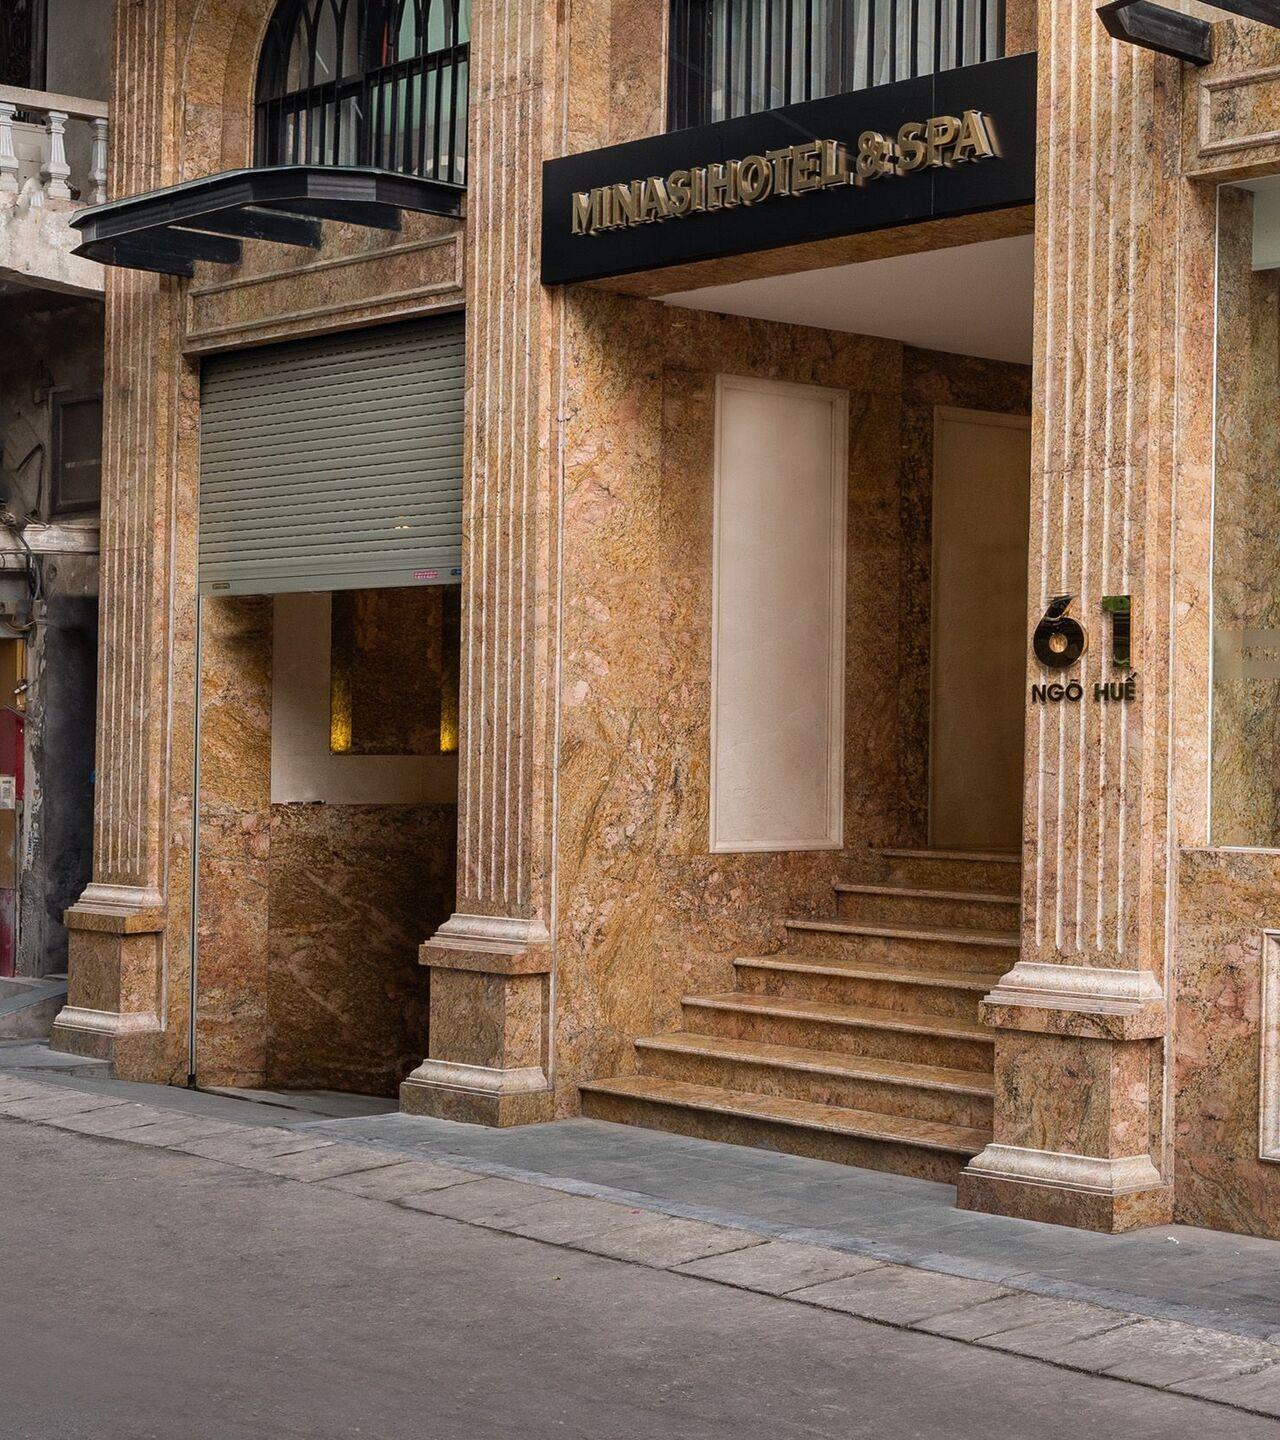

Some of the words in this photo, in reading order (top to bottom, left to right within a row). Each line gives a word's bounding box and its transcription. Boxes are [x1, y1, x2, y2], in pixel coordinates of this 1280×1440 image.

[571, 166, 706, 236] MINASI
[706, 139, 849, 209] HOTEL
[857, 131, 892, 180] &
[897, 109, 997, 172] SPA
[1033, 594, 1133, 668] 61
[1031, 679, 1083, 702] NGÕ
[1094, 672, 1137, 702] HUẾ
